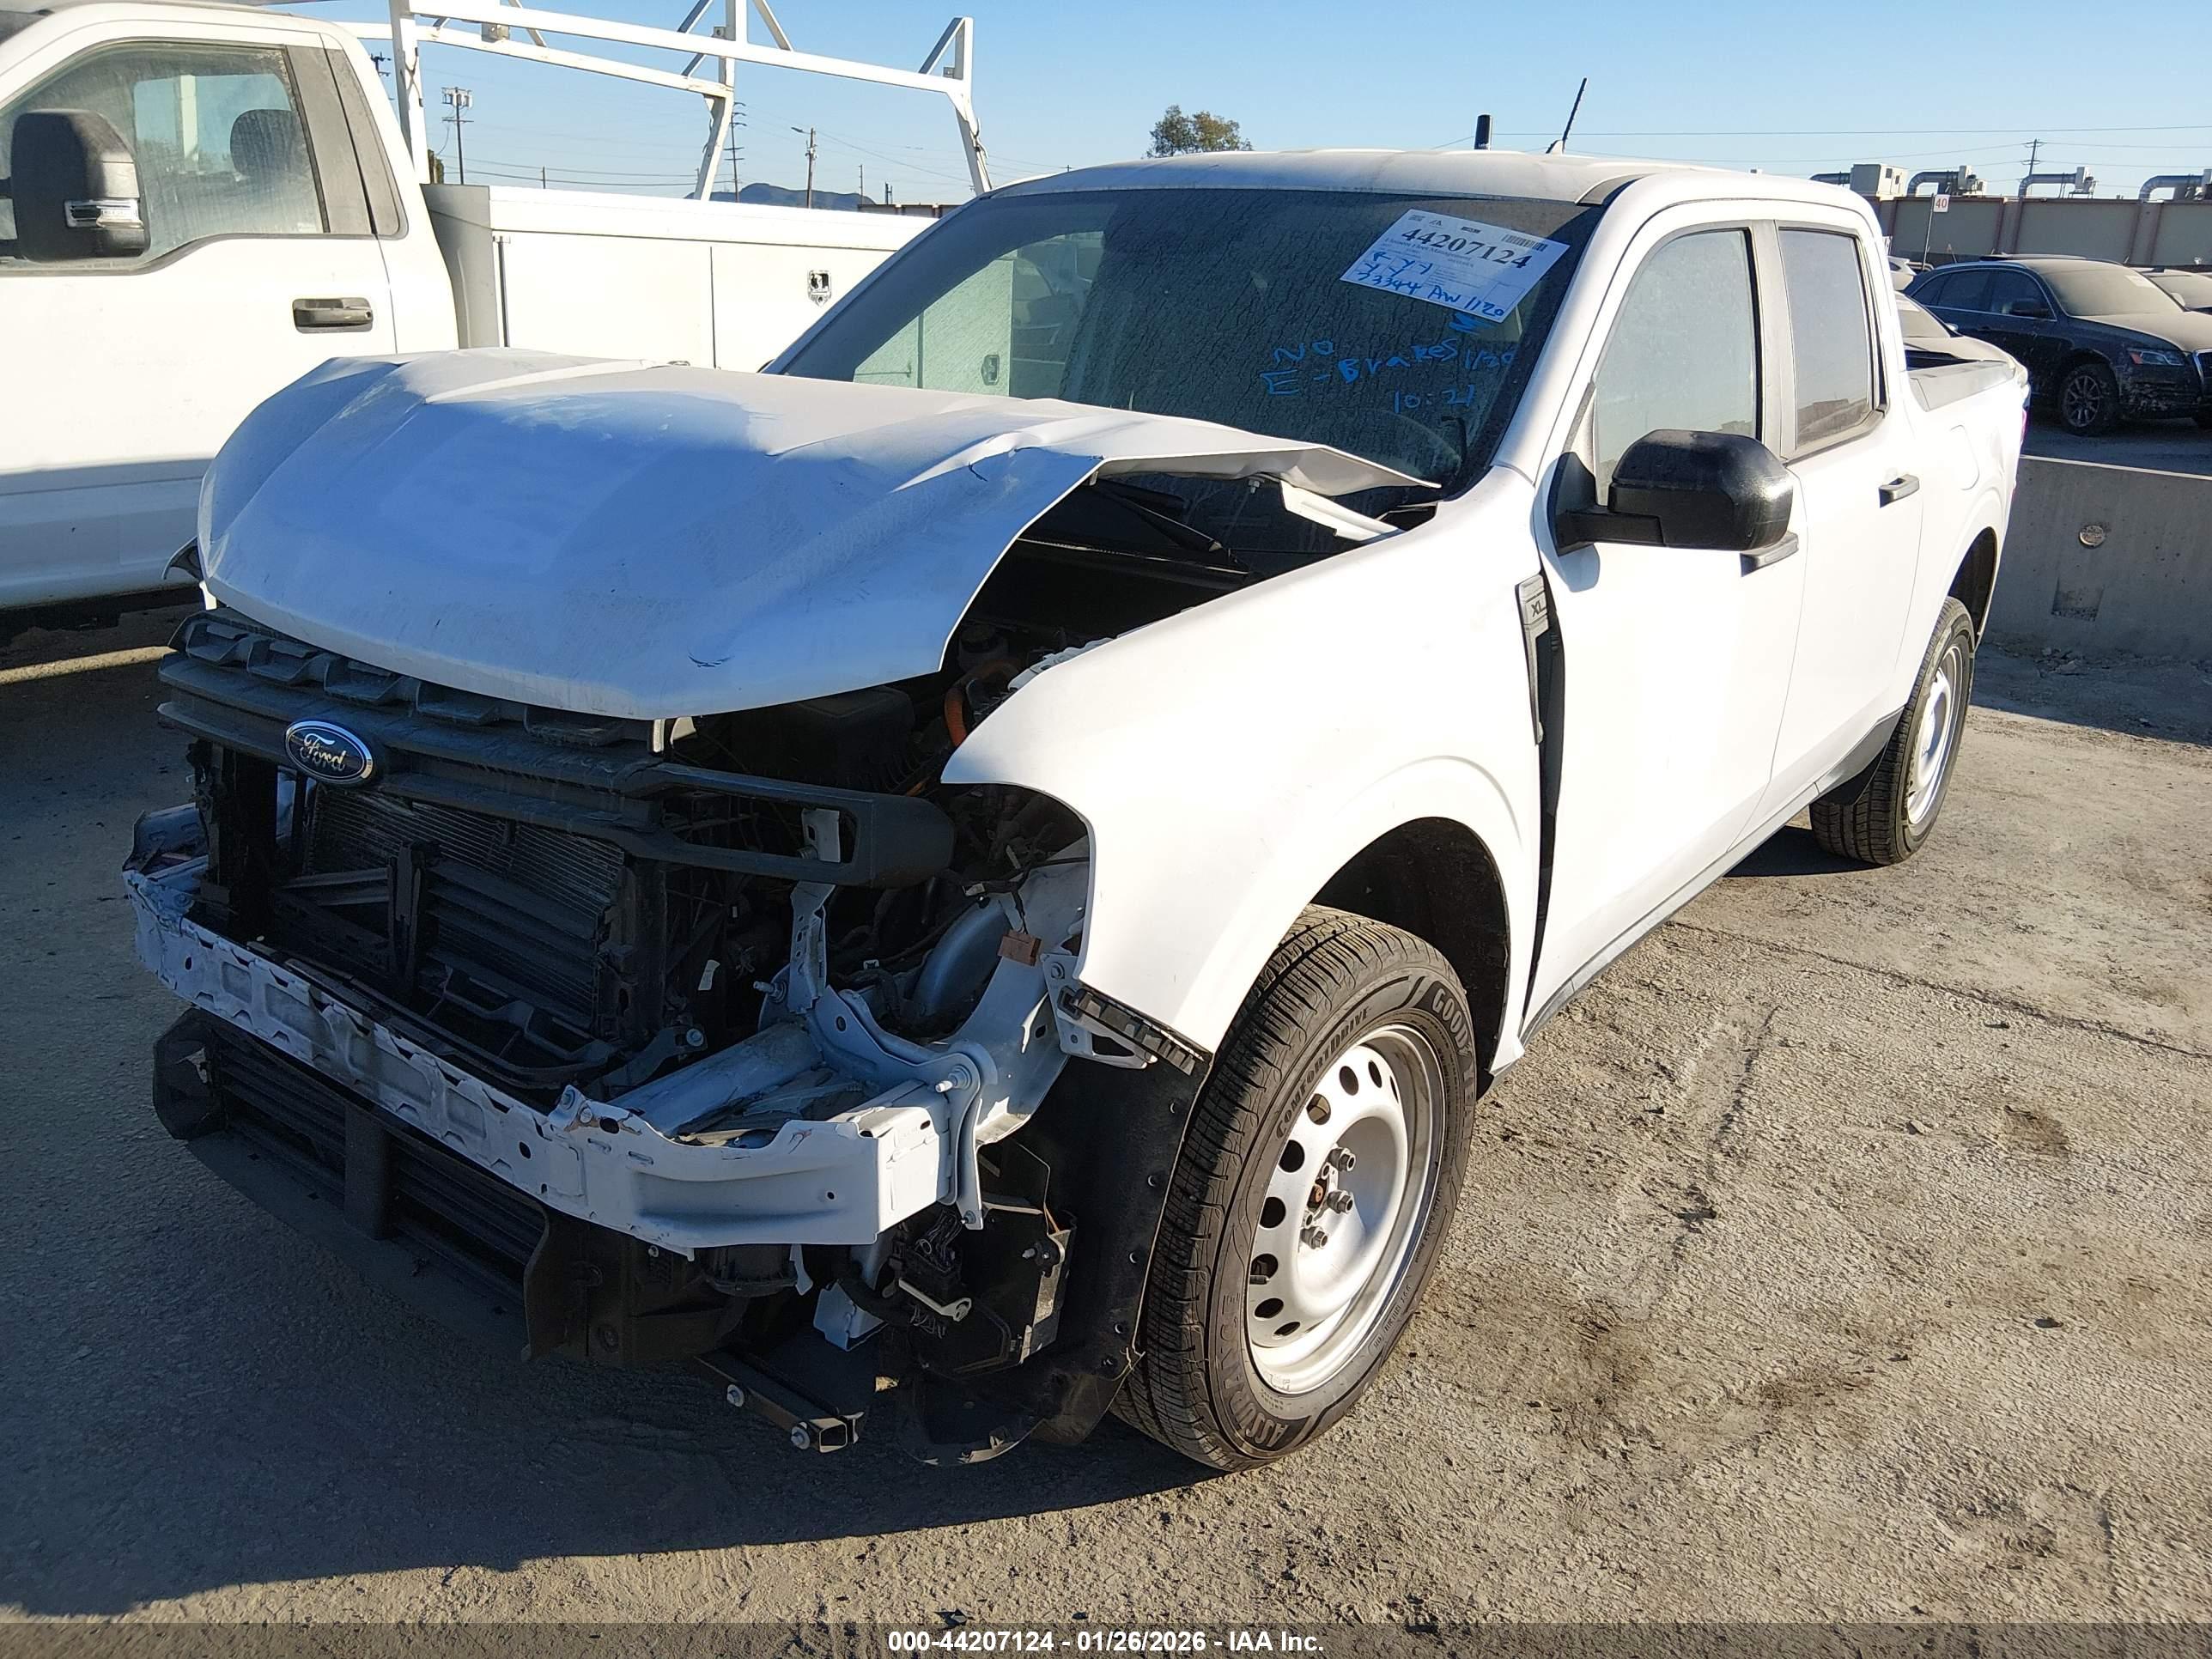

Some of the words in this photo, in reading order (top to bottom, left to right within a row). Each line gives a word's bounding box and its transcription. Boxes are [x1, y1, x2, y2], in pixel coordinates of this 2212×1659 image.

[1936, 198, 1948, 208] 40
[1401, 228, 1533, 269] 44207124
[1531, 600, 1547, 617] XL
[299, 732, 347, 771] Ford
